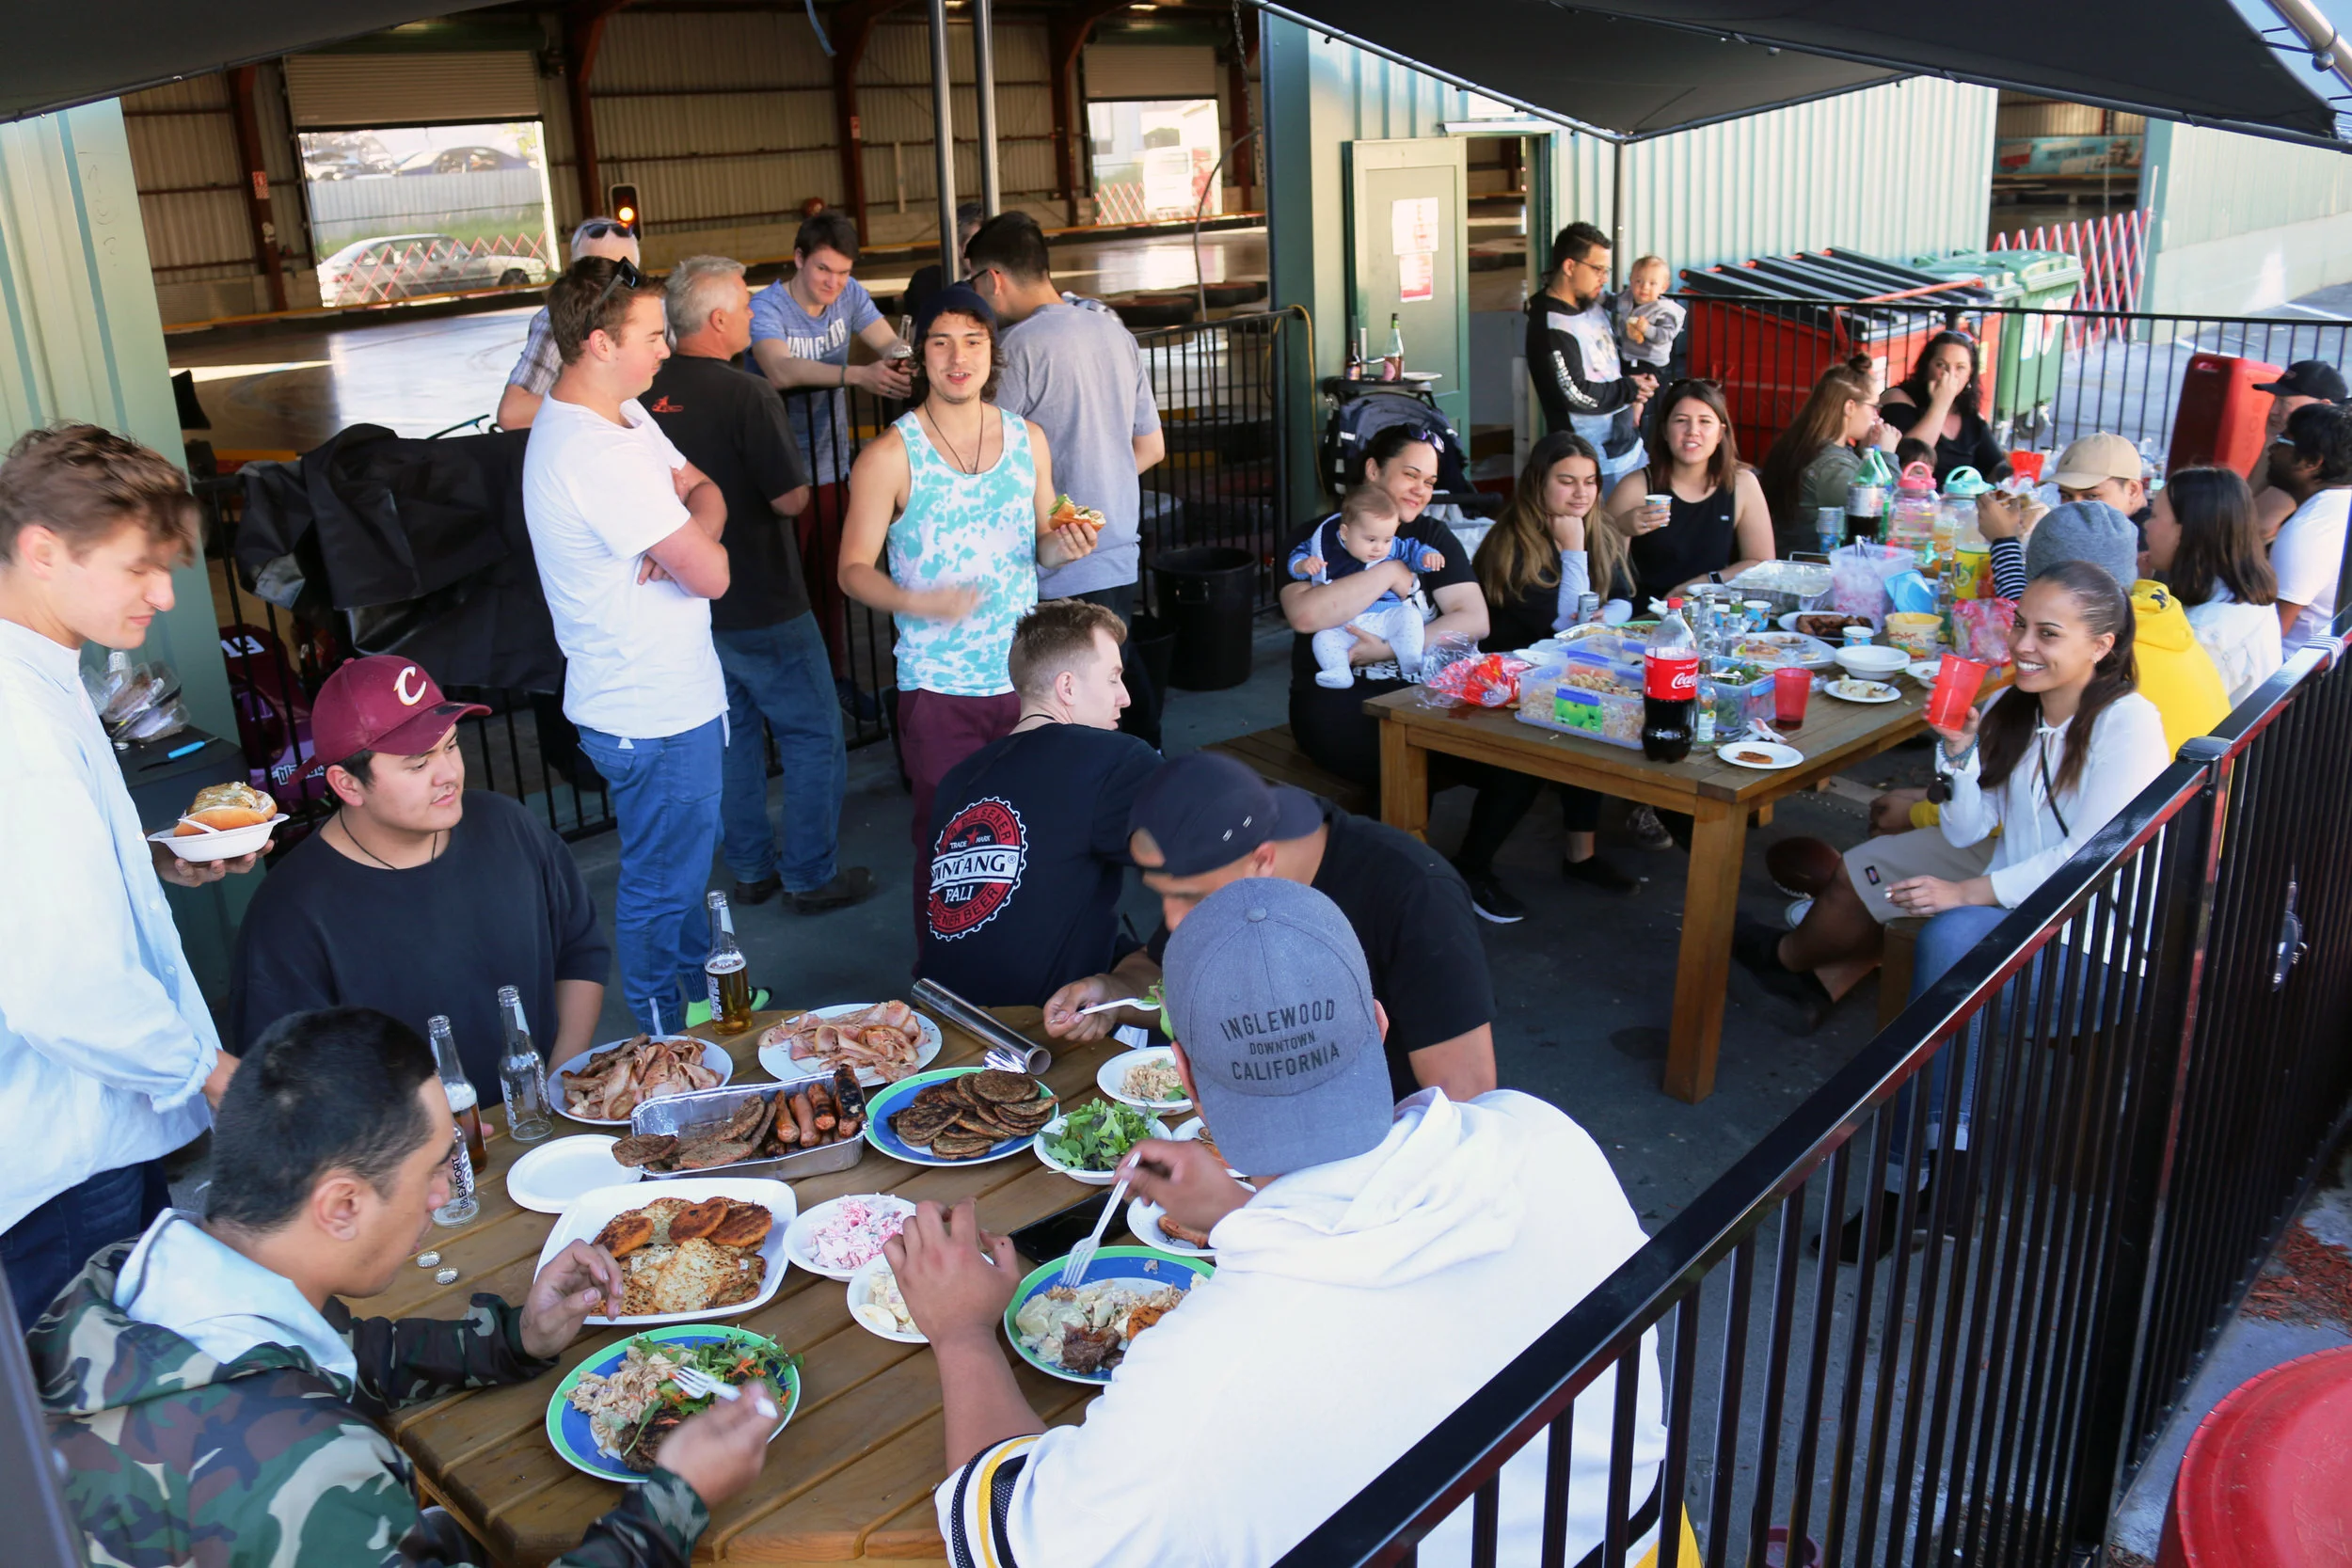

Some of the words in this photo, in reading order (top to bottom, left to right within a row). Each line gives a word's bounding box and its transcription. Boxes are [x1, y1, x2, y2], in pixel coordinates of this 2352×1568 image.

[393, 666, 427, 706] C
[949, 840, 968, 849] TRADE
[975, 835, 992, 844] MARK
[963, 887, 999, 921] BEER
[1220, 999, 1335, 1041] INGLEWOOD
[1231, 1041, 1341, 1081] CALIFORNIA
[1249, 1030, 1316, 1055] DOWNTOWN
[452, 1157, 468, 1198] EXPORT
[461, 1150, 474, 1193] GOLD
